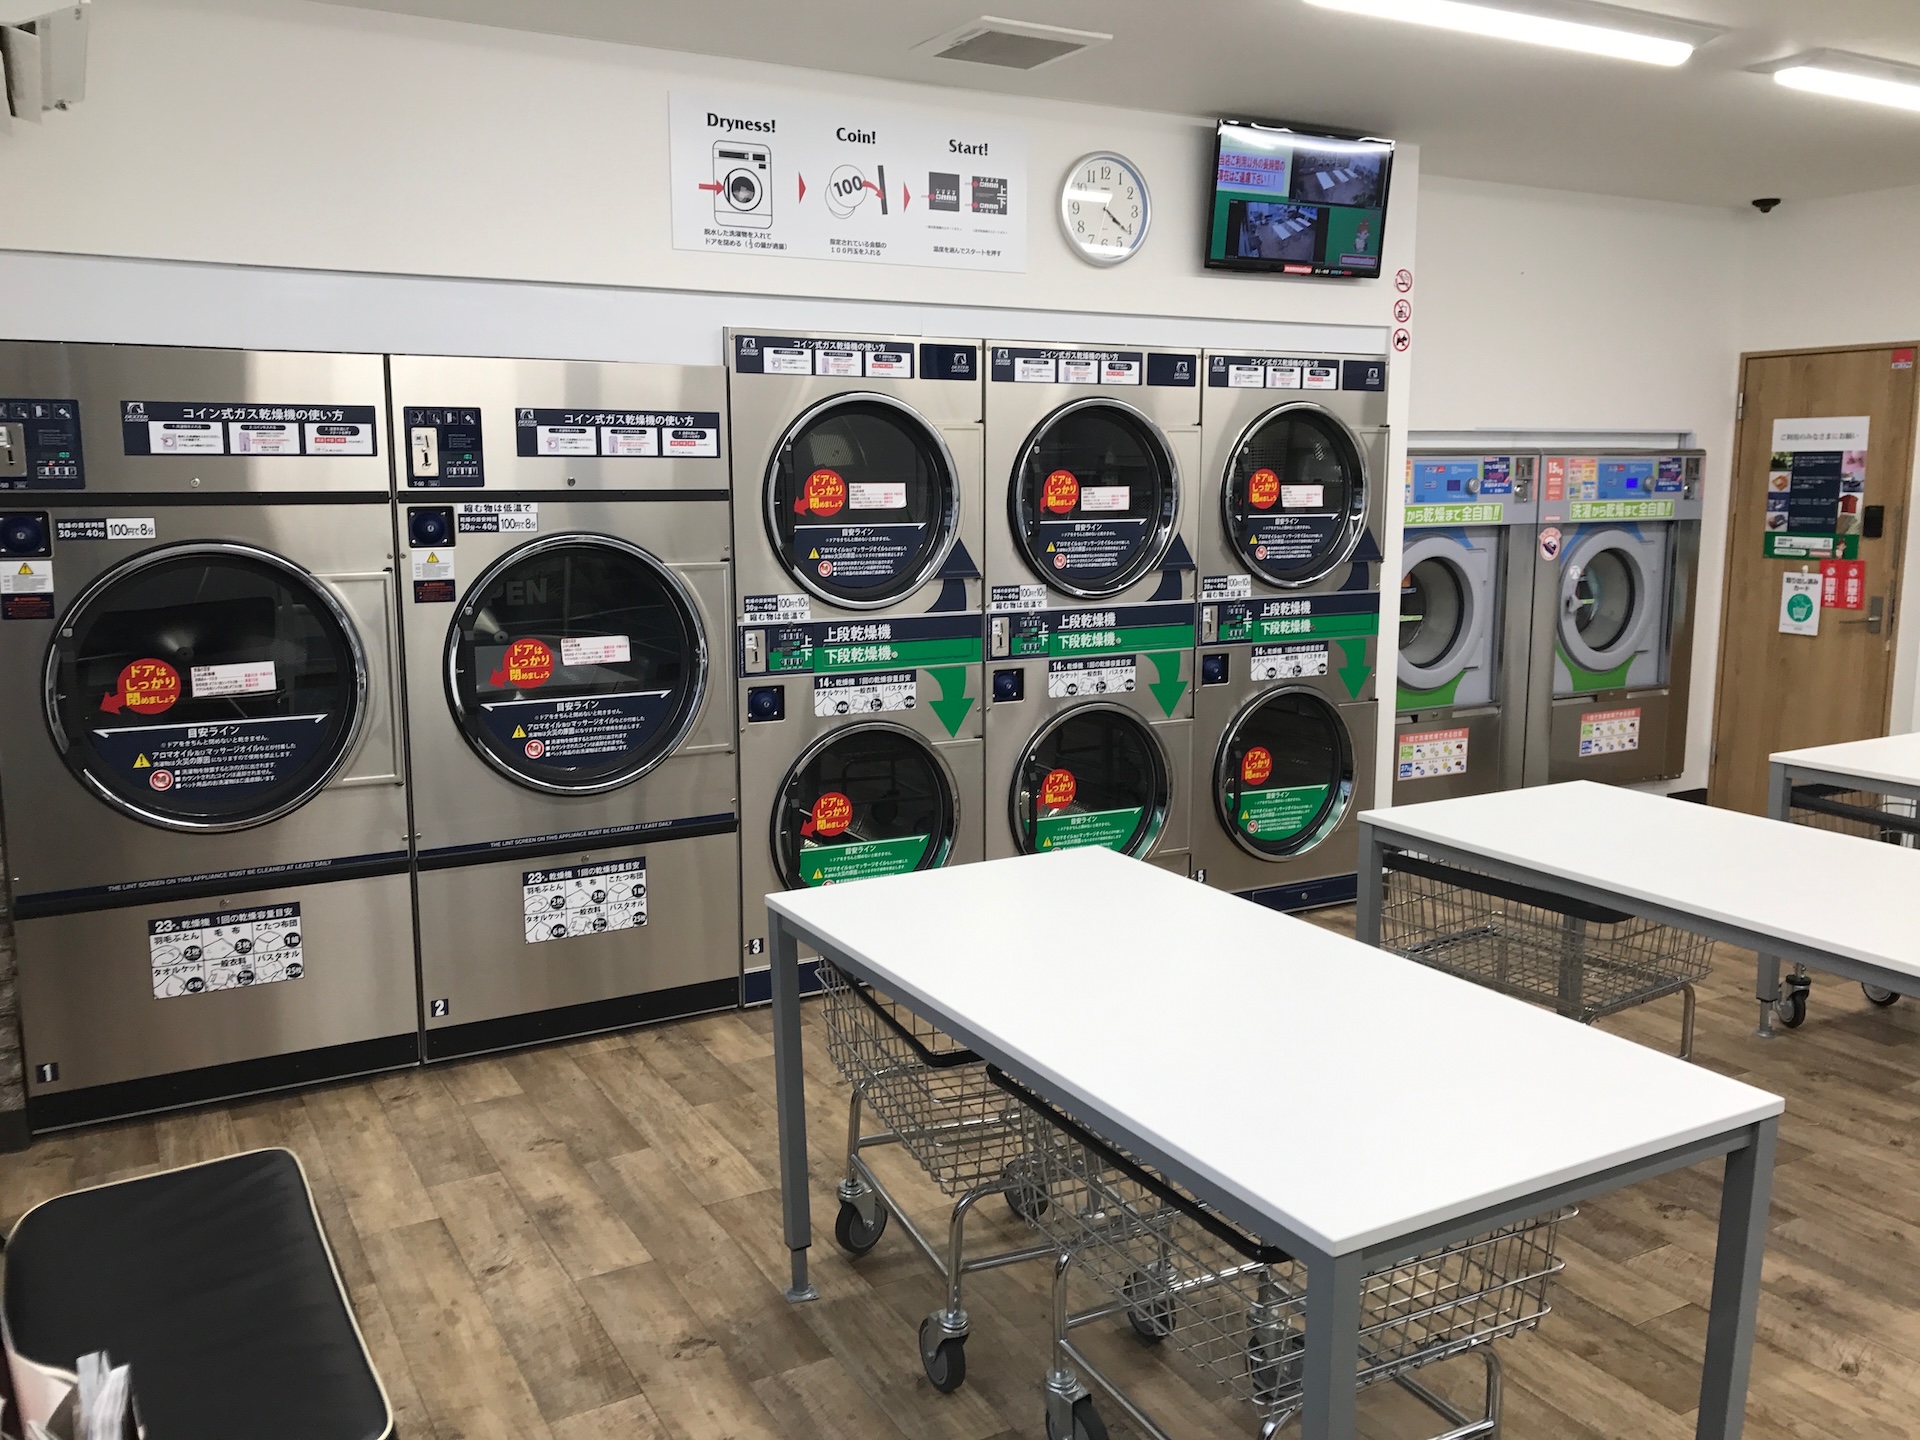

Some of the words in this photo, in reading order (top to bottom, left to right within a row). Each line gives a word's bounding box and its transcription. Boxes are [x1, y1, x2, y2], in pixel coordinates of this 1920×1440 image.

[707, 112, 776, 133] Dryness!
[836, 127, 876, 145] Coin!
[949, 139, 988, 156] Start!
[1087, 170, 1095, 183] 11
[1101, 166, 1111, 180] 12
[1119, 172, 1122, 185] 1
[833, 175, 863, 198] 100
[1127, 186, 1134, 200] 2
[1072, 201, 1080, 215] 9
[1131, 205, 1138, 218] 3
[1077, 220, 1085, 233] 8
[1127, 223, 1132, 235] 4
[830, 238, 887, 248] 指定されている金額の
[1088, 234, 1095, 244] 7
[1116, 236, 1122, 248] 5
[793, 340, 886, 351] コイン式ガス乾燥機の使い方
[1040, 350, 1119, 360] コイン式ガス乾燥機の使い方
[1251, 359, 1319, 367] コイン式ガス乾燥機の使い方
[183, 408, 344, 421] コイン式ガス乾燥機の使い方
[564, 414, 694, 426] コイン式ガス乾燥機の使い方
[1548, 463, 1563, 475] 15kg
[813, 475, 837, 485] ドアは
[1051, 476, 1071, 484] ドアは
[1256, 474, 1273, 482] ドアは
[810, 485, 842, 496] しっかり
[1048, 484, 1076, 495] しっかり
[1252, 482, 1277, 492] しっかり
[810, 498, 842, 509] 閉めましょう
[1048, 496, 1076, 506] 閉めましょう
[464, 504, 531, 512] 縮む物は低温で
[1405, 506, 1501, 522] から乾燥まで全自動!!
[501, 519, 536, 529] 100円で8分
[110, 524, 154, 536] 100円で8分
[842, 528, 874, 536] 目安ライン
[1260, 601, 1311, 616] 上段乾燥機
[1058, 612, 1116, 629] 上段乾燥機
[1243, 610, 1252, 621] 上
[1038, 622, 1048, 634] 上
[1243, 622, 1252, 632] 下
[1260, 620, 1311, 634] 下段乾燥機
[823, 624, 892, 643] 上段乾燥機
[801, 635, 812, 648] 上
[1039, 635, 1048, 646] 下
[1058, 632, 1116, 649] 下段乾燥機
[514, 644, 542, 655] ドアは
[801, 648, 812, 661] 下
[824, 645, 892, 664] 下段乾燥機
[510, 655, 550, 666] しっかり
[130, 665, 167, 678] ドアは
[510, 669, 549, 680] 閉めましょう
[1050, 671, 1078, 679] タオルケット
[125, 678, 176, 690] しっかり
[126, 692, 176, 705] 閉めましょう
[556, 701, 599, 711] 目安ライン
[187, 726, 240, 738] 目安ライン
[1249, 752, 1266, 760] ドアは
[1246, 759, 1270, 769] しっかり
[1049, 773, 1069, 783] ドアは
[1046, 781, 1073, 792] しっかり
[821, 798, 844, 808] ドアは
[818, 806, 849, 818] しっかり
[817, 820, 849, 831] 閉めましょう
[559, 831, 587, 840] APPLIANCE
[845, 845, 876, 855] 目安ライン
[138, 880, 165, 888] SCREEN
[193, 872, 228, 882] APPLIANCE
[257, 865, 285, 874] CLEANED
[609, 872, 643, 882] こたつ布団
[1198, 870, 1204, 882] 5
[527, 885, 563, 894] 羽毛ぶとん
[610, 900, 644, 910] バスタオル
[573, 907, 600, 915] 一般衣料
[526, 912, 565, 922] タオルケット
[255, 919, 298, 931] こたつ布団
[154, 933, 199, 944] 羽毛ぶとん
[236, 940, 250, 949] 3枚
[753, 939, 760, 954] 3
[257, 950, 300, 962] バスタオル
[212, 958, 247, 968] 一般衣料
[154, 964, 203, 976] タオルケット
[187, 980, 204, 989] 6枚
[436, 1000, 444, 1015] 2
[43, 1064, 52, 1081] 1
